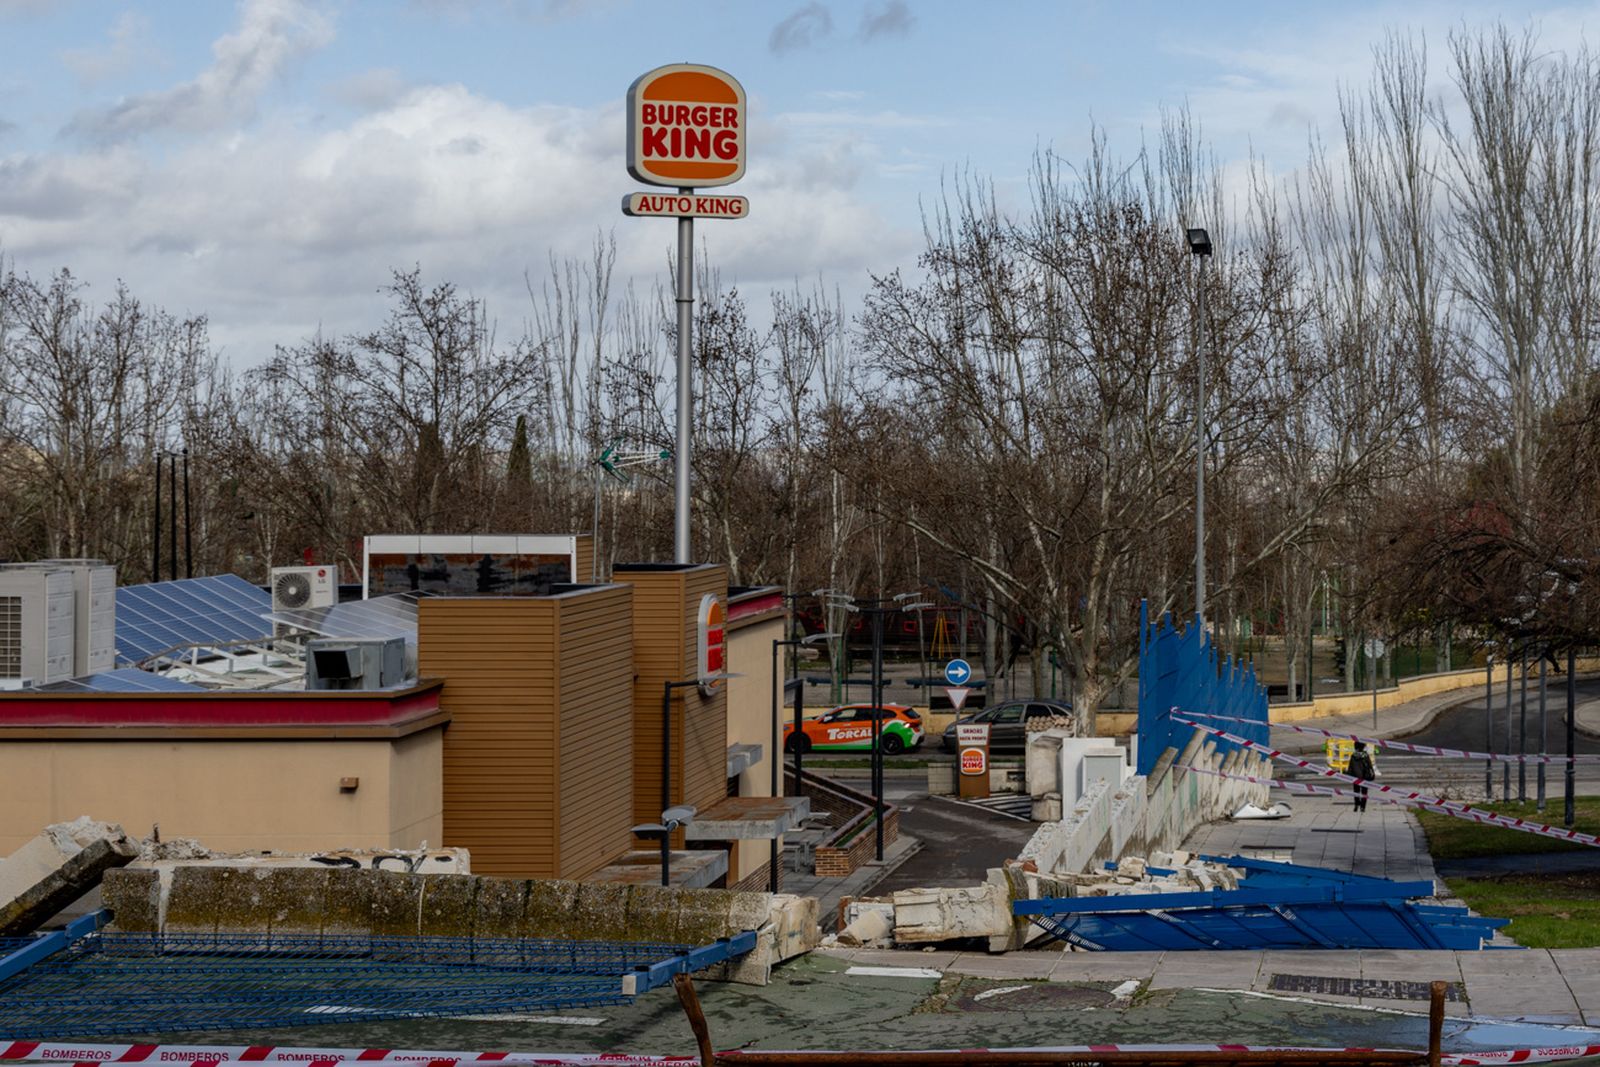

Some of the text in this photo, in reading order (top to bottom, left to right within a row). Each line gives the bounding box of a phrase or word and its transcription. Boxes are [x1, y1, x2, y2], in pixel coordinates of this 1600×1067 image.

[642, 104, 738, 128] BURGER
[642, 126, 738, 160] KING
[638, 196, 742, 214] AUTO KING
[42, 1049, 112, 1060] BOMBEROS
[160, 1051, 229, 1062] BOMBEROS
